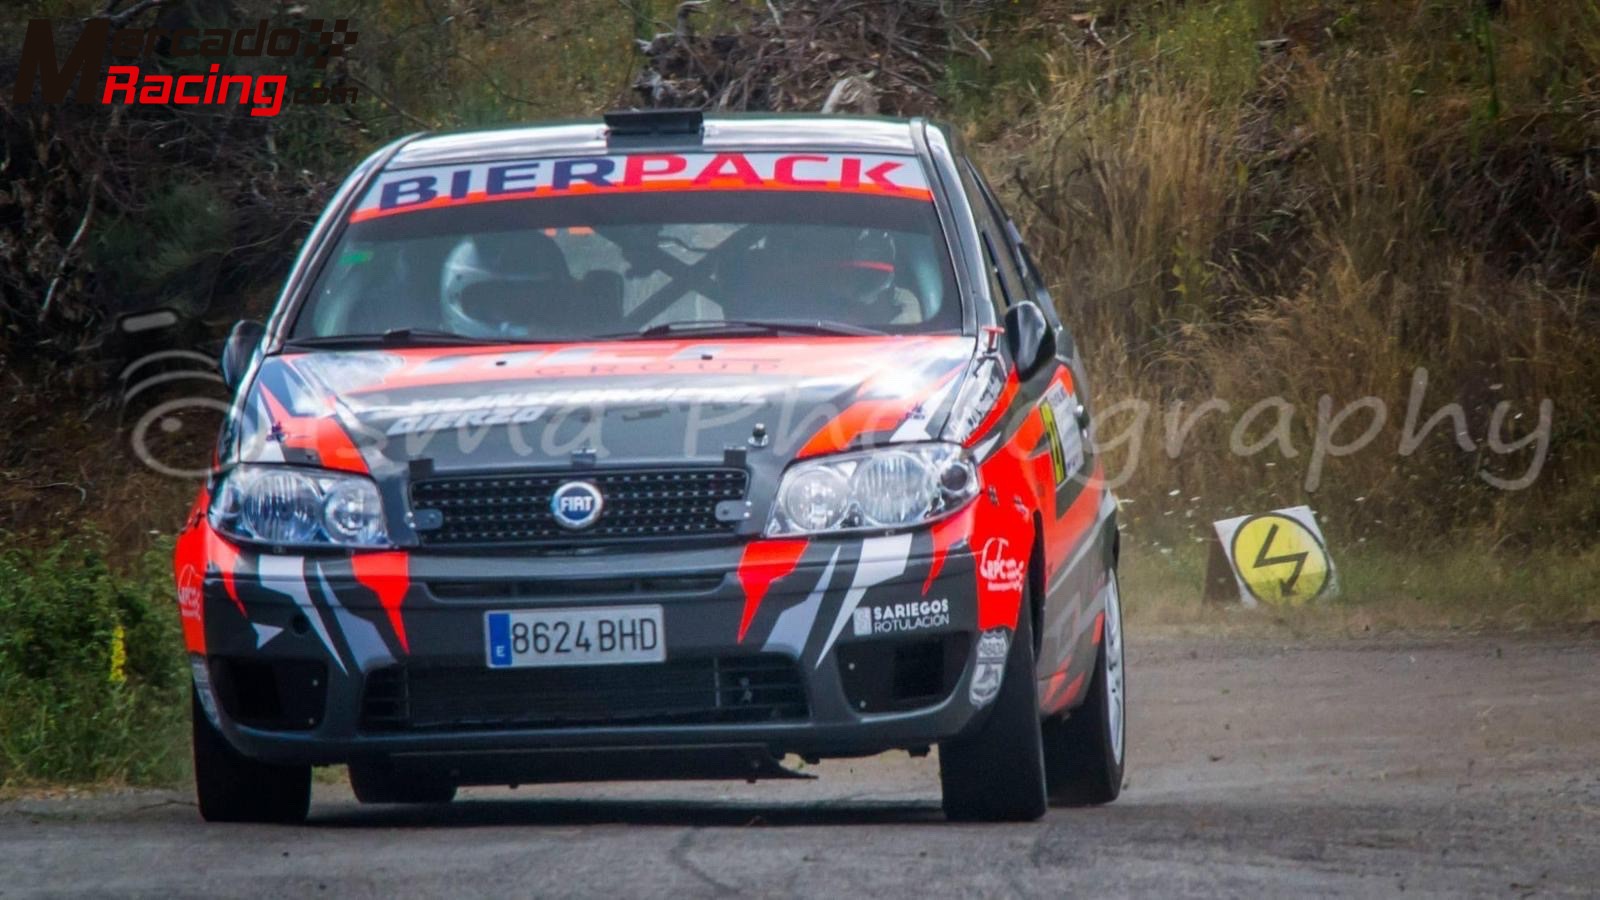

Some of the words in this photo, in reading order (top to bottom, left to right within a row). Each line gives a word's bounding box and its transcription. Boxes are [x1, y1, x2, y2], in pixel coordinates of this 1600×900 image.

[380, 152, 908, 210] BIERPACK
[560, 496, 593, 512] FIAT
[873, 598, 949, 621] SARIEGOS
[511, 620, 591, 654] 8624
[598, 618, 658, 652] BHD
[496, 645, 505, 657] E
